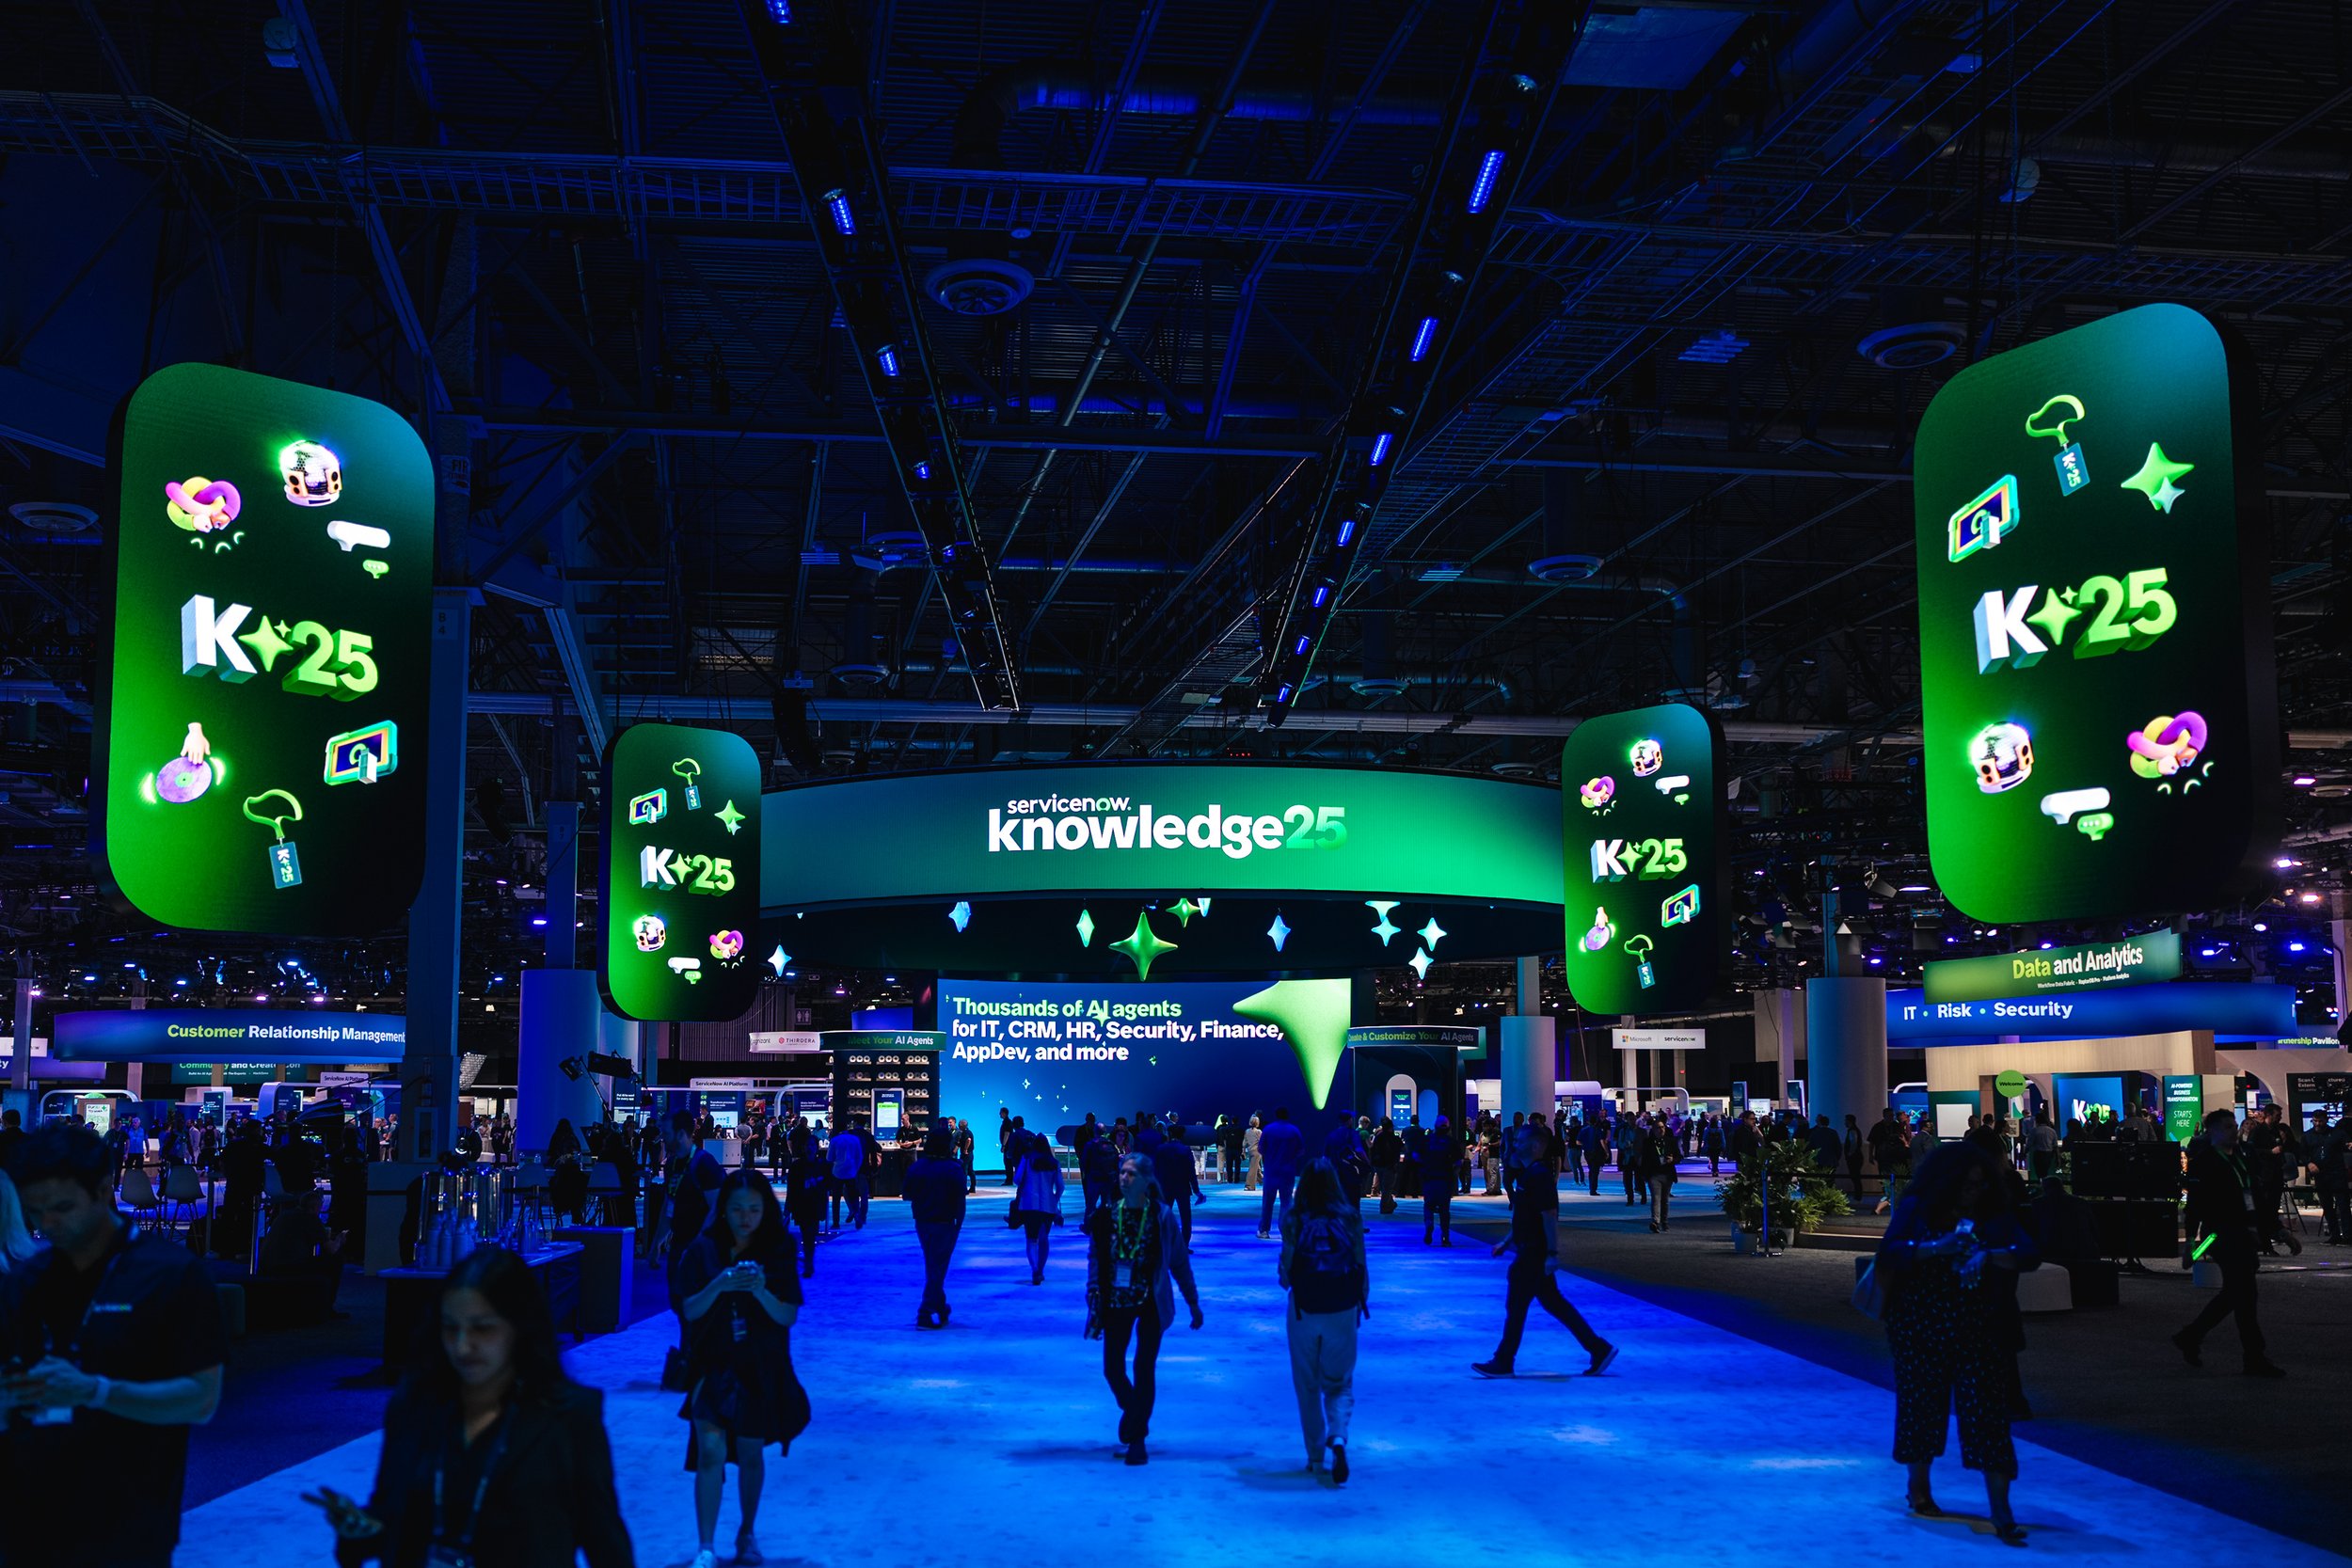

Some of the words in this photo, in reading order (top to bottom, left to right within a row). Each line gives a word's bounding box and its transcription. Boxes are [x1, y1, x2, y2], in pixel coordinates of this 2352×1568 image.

[2012, 957, 2052, 979] Data
[2053, 952, 2083, 975] and
[2085, 943, 2143, 971] Analytics
[953, 997, 1059, 1017] Thousands
[1062, 1000, 1083, 1017] of
[1087, 1000, 1108, 1017] AI
[1113, 1000, 1182, 1021] agents
[1903, 1006, 1916, 1021] IT
[1937, 1003, 1972, 1018] Risk
[1994, 1001, 2073, 1019] Security
[167, 1024, 246, 1038] Customer
[248, 1024, 340, 1041] Relationship
[342, 1027, 405, 1043] Management
[952, 1020, 977, 1037] for
[981, 1021, 1004, 1040] IT,
[1008, 1021, 1062, 1041] CRM,
[1067, 1021, 1102, 1041] HR,
[1106, 1021, 1197, 1042] Security,
[1200, 1021, 1284, 1040] Finance,
[1369, 1032, 1416, 1041] Customize
[1418, 1031, 1439, 1040] Your
[1440, 1032, 1451, 1040] AI
[1452, 1033, 1474, 1042] Agents
[848, 1036, 870, 1044] Meet
[872, 1036, 893, 1044] Your
[895, 1036, 905, 1044] AI
[907, 1036, 934, 1046] Agents
[2278, 1037, 2312, 1046] artnership
[952, 1042, 1031, 1063] AppDev,
[1035, 1042, 1073, 1061] and
[1075, 1046, 1129, 1061] more
[2173, 1110, 2193, 1118] STARTS
[2176, 1119, 2190, 1128] HERE
